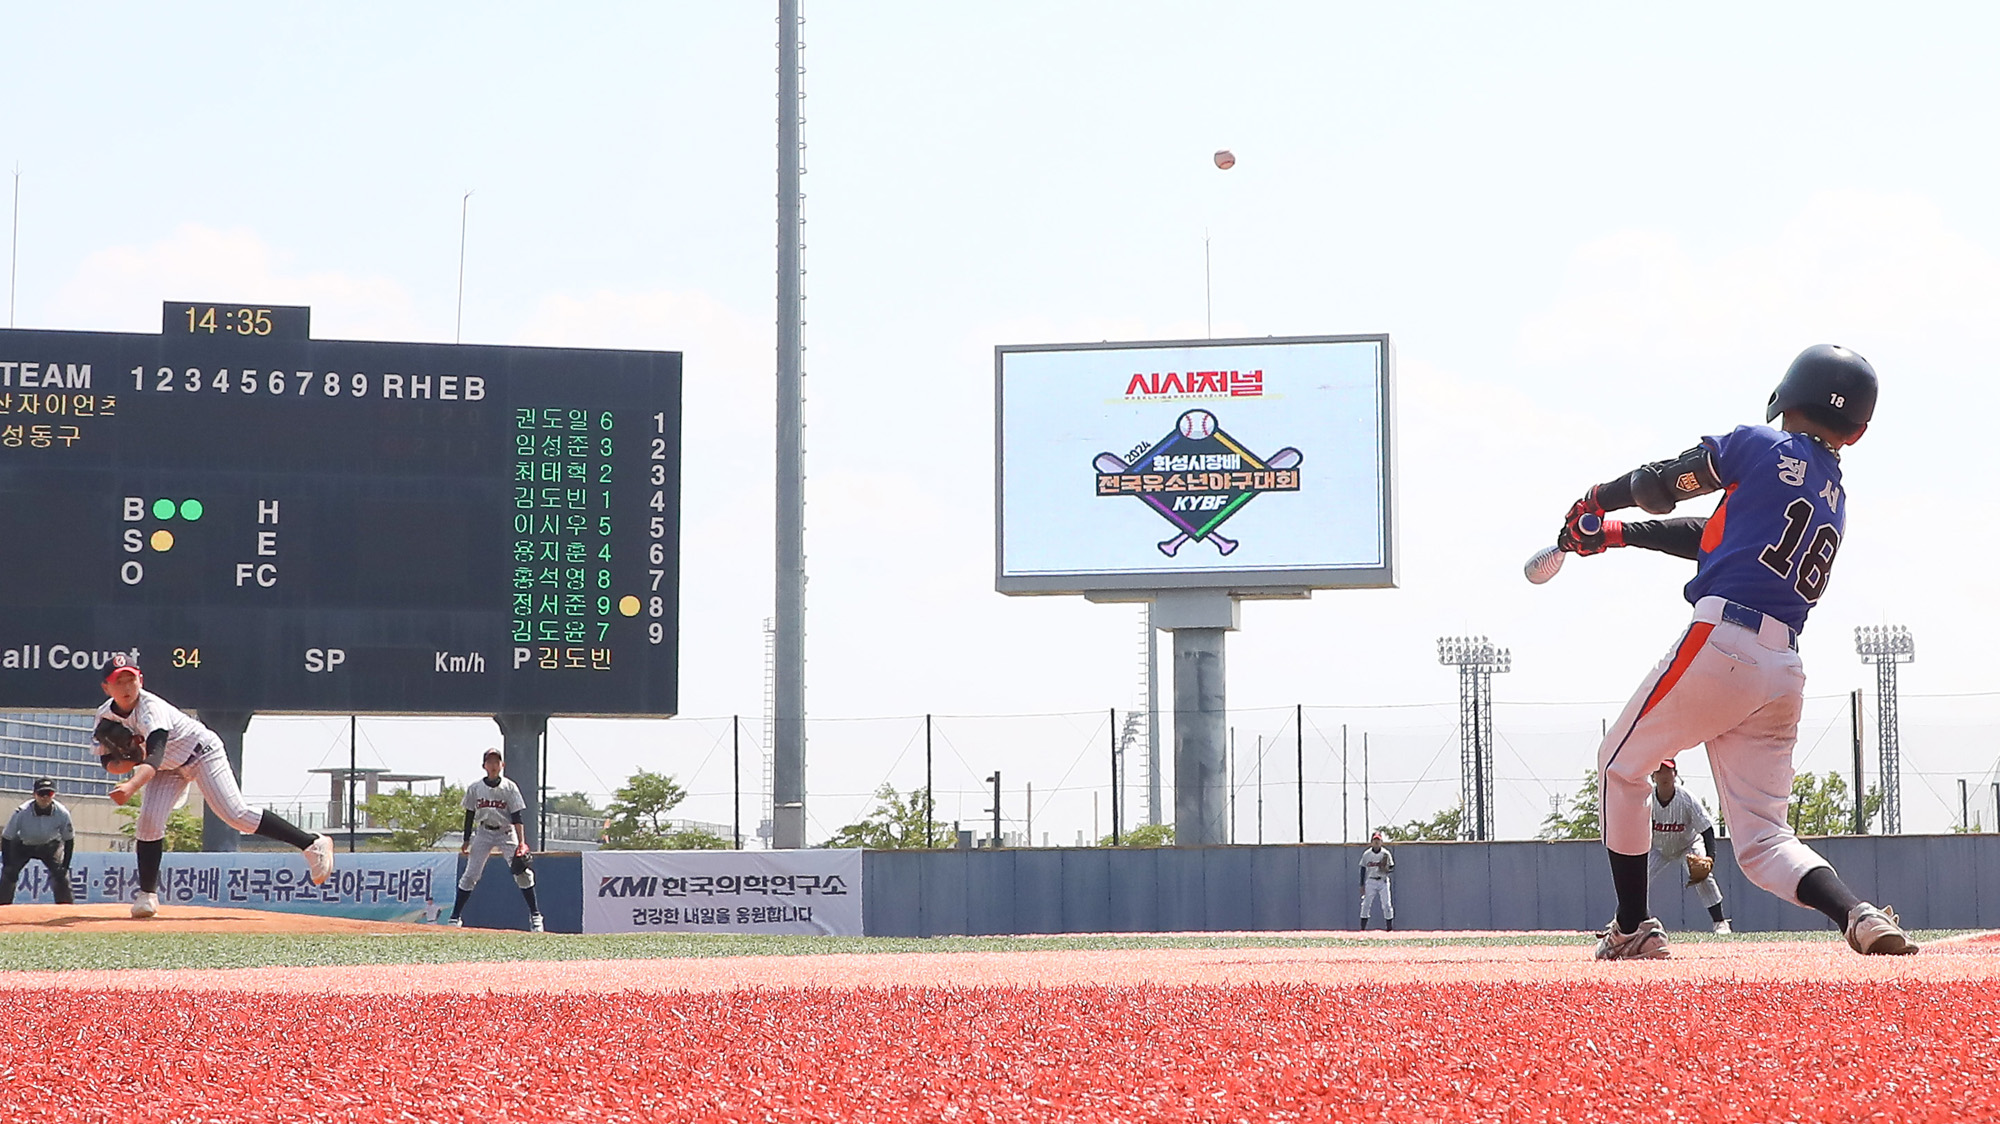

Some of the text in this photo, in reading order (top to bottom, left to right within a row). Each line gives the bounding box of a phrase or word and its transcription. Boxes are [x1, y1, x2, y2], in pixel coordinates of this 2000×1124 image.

[186, 307, 272, 335] 14:35
[0, 362, 91, 388] TEAM
[1126, 370, 1263, 397] 시사저널
[1830, 393, 1846, 409] 18
[516, 409, 663, 433] 권도일 6 1
[2, 425, 80, 447] 성동구
[517, 435, 665, 459] 임성준 3 2
[1124, 441, 1151, 463] 2024
[1153, 454, 1241, 472] 화성시장배
[515, 462, 664, 485] 최태혁 2 3
[1099, 471, 1298, 493] 전국유소년야구대회
[124, 498, 144, 520] B
[514, 487, 665, 511] 김도빈 1 4
[1173, 495, 1229, 511] KYBF
[259, 500, 278, 523] H
[515, 514, 664, 538] 이시우 5 5
[124, 529, 142, 552] S
[258, 532, 276, 555] E
[1759, 497, 1841, 604] 18
[598, 544, 611, 562] 4
[650, 544, 663, 564] 6
[598, 570, 610, 588] 8
[649, 570, 664, 591] 7
[513, 594, 663, 617] 정서준 9 8
[512, 620, 662, 643] 김도윤 7 9
[0, 645, 40, 670] all
[173, 648, 200, 667] 34
[305, 649, 345, 672] SP
[436, 652, 484, 672] Km/h
[514, 648, 610, 669] P 김도빈
[227, 868, 433, 902] 전국유소년야구대회
[598, 875, 847, 897] KMI 한국의학연구소
[632, 907, 679, 925] 건강한
[684, 907, 731, 925] 내일을
